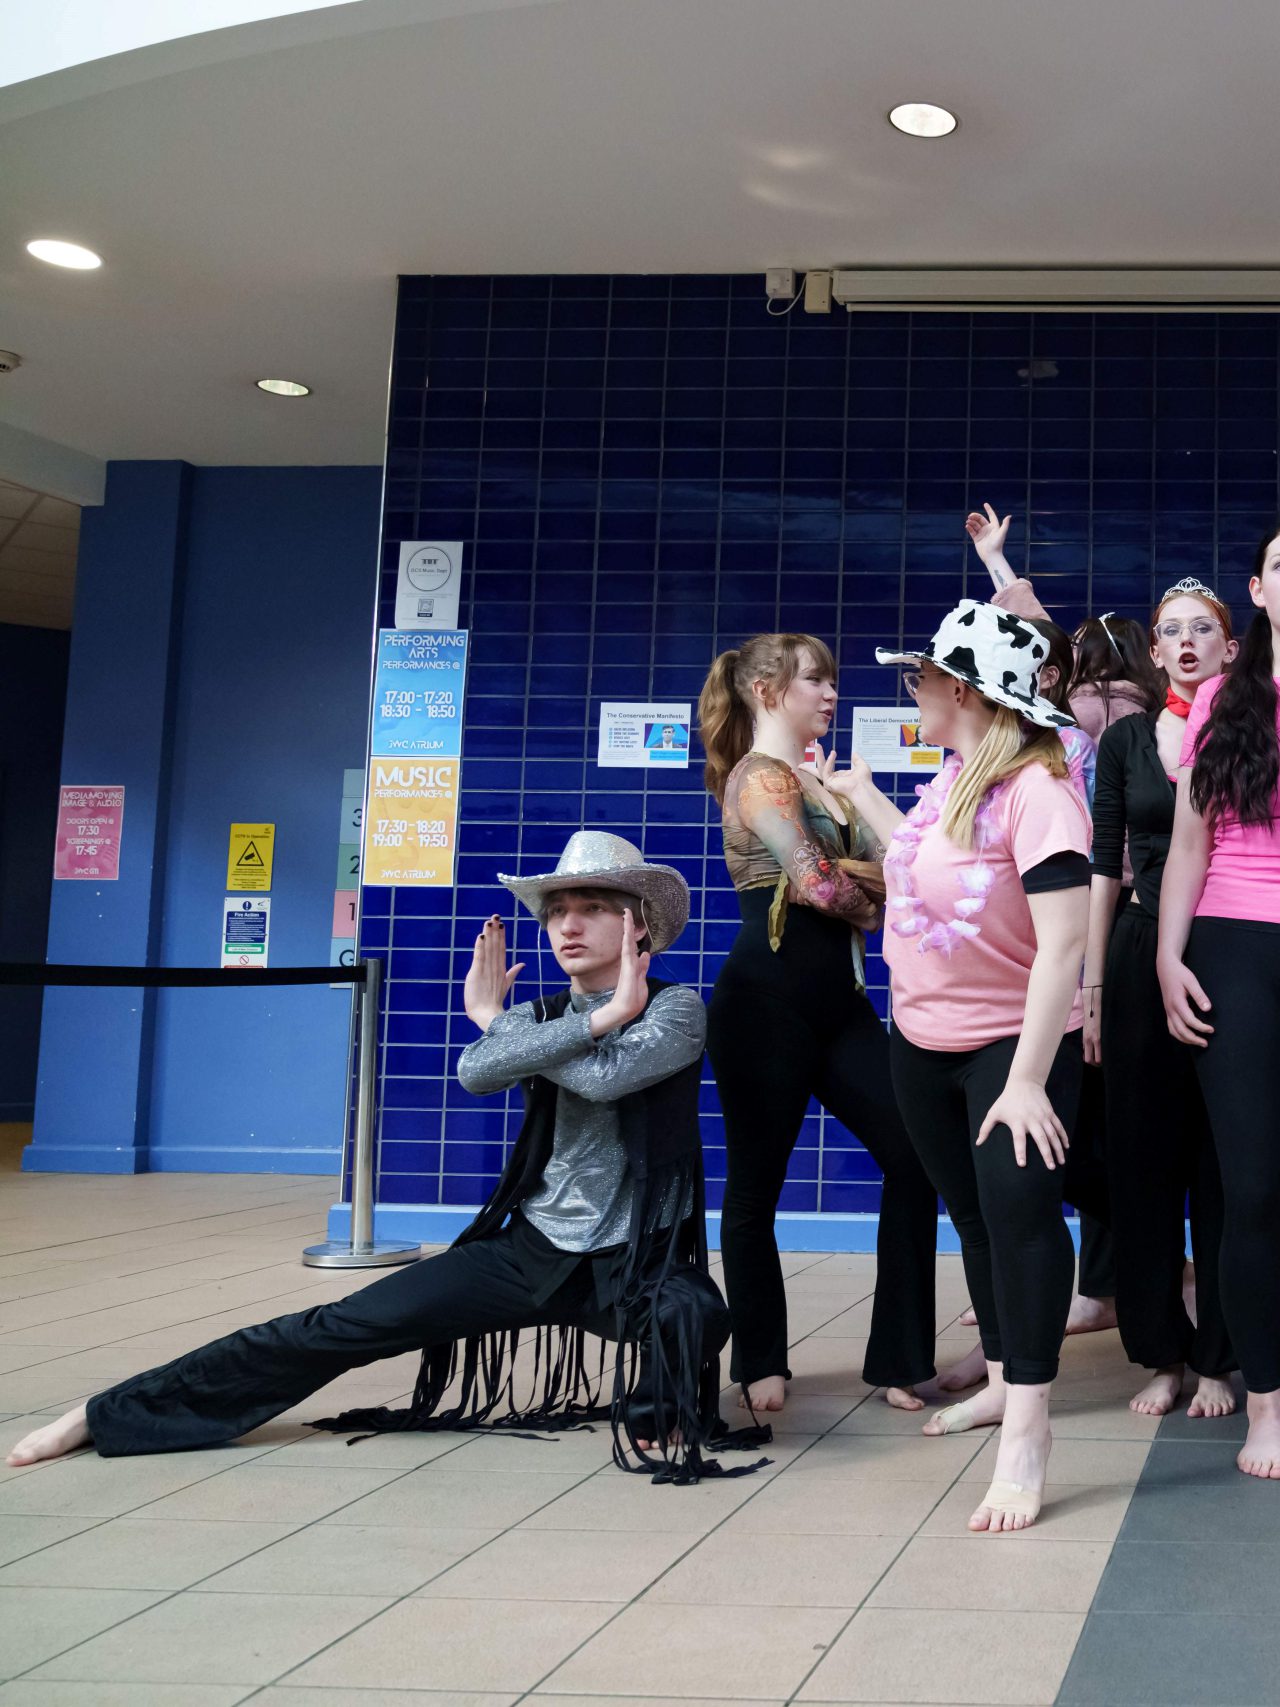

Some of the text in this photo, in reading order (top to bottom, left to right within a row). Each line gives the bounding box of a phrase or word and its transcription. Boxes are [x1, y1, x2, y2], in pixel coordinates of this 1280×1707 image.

[384, 634, 464, 647] PERFORMING
[409, 647, 438, 658] ARTS
[383, 660, 460, 670] PERFORMANCES @
[380, 704, 410, 718] 18:30
[426, 706, 456, 718] 18:50
[388, 740, 444, 749] JWC ATRIUM
[376, 766, 452, 788] MUSIC
[374, 789, 442, 798] PERFORMANCES
[352, 808, 362, 828] 3
[78, 826, 100, 836] 17:30
[372, 834, 402, 846] 19:00
[418, 834, 448, 848] 19:50
[76, 846, 98, 856] 17:45
[350, 856, 360, 874] 2
[381, 870, 436, 878] JWC ATRIUM
[348, 902, 356, 920] 1
